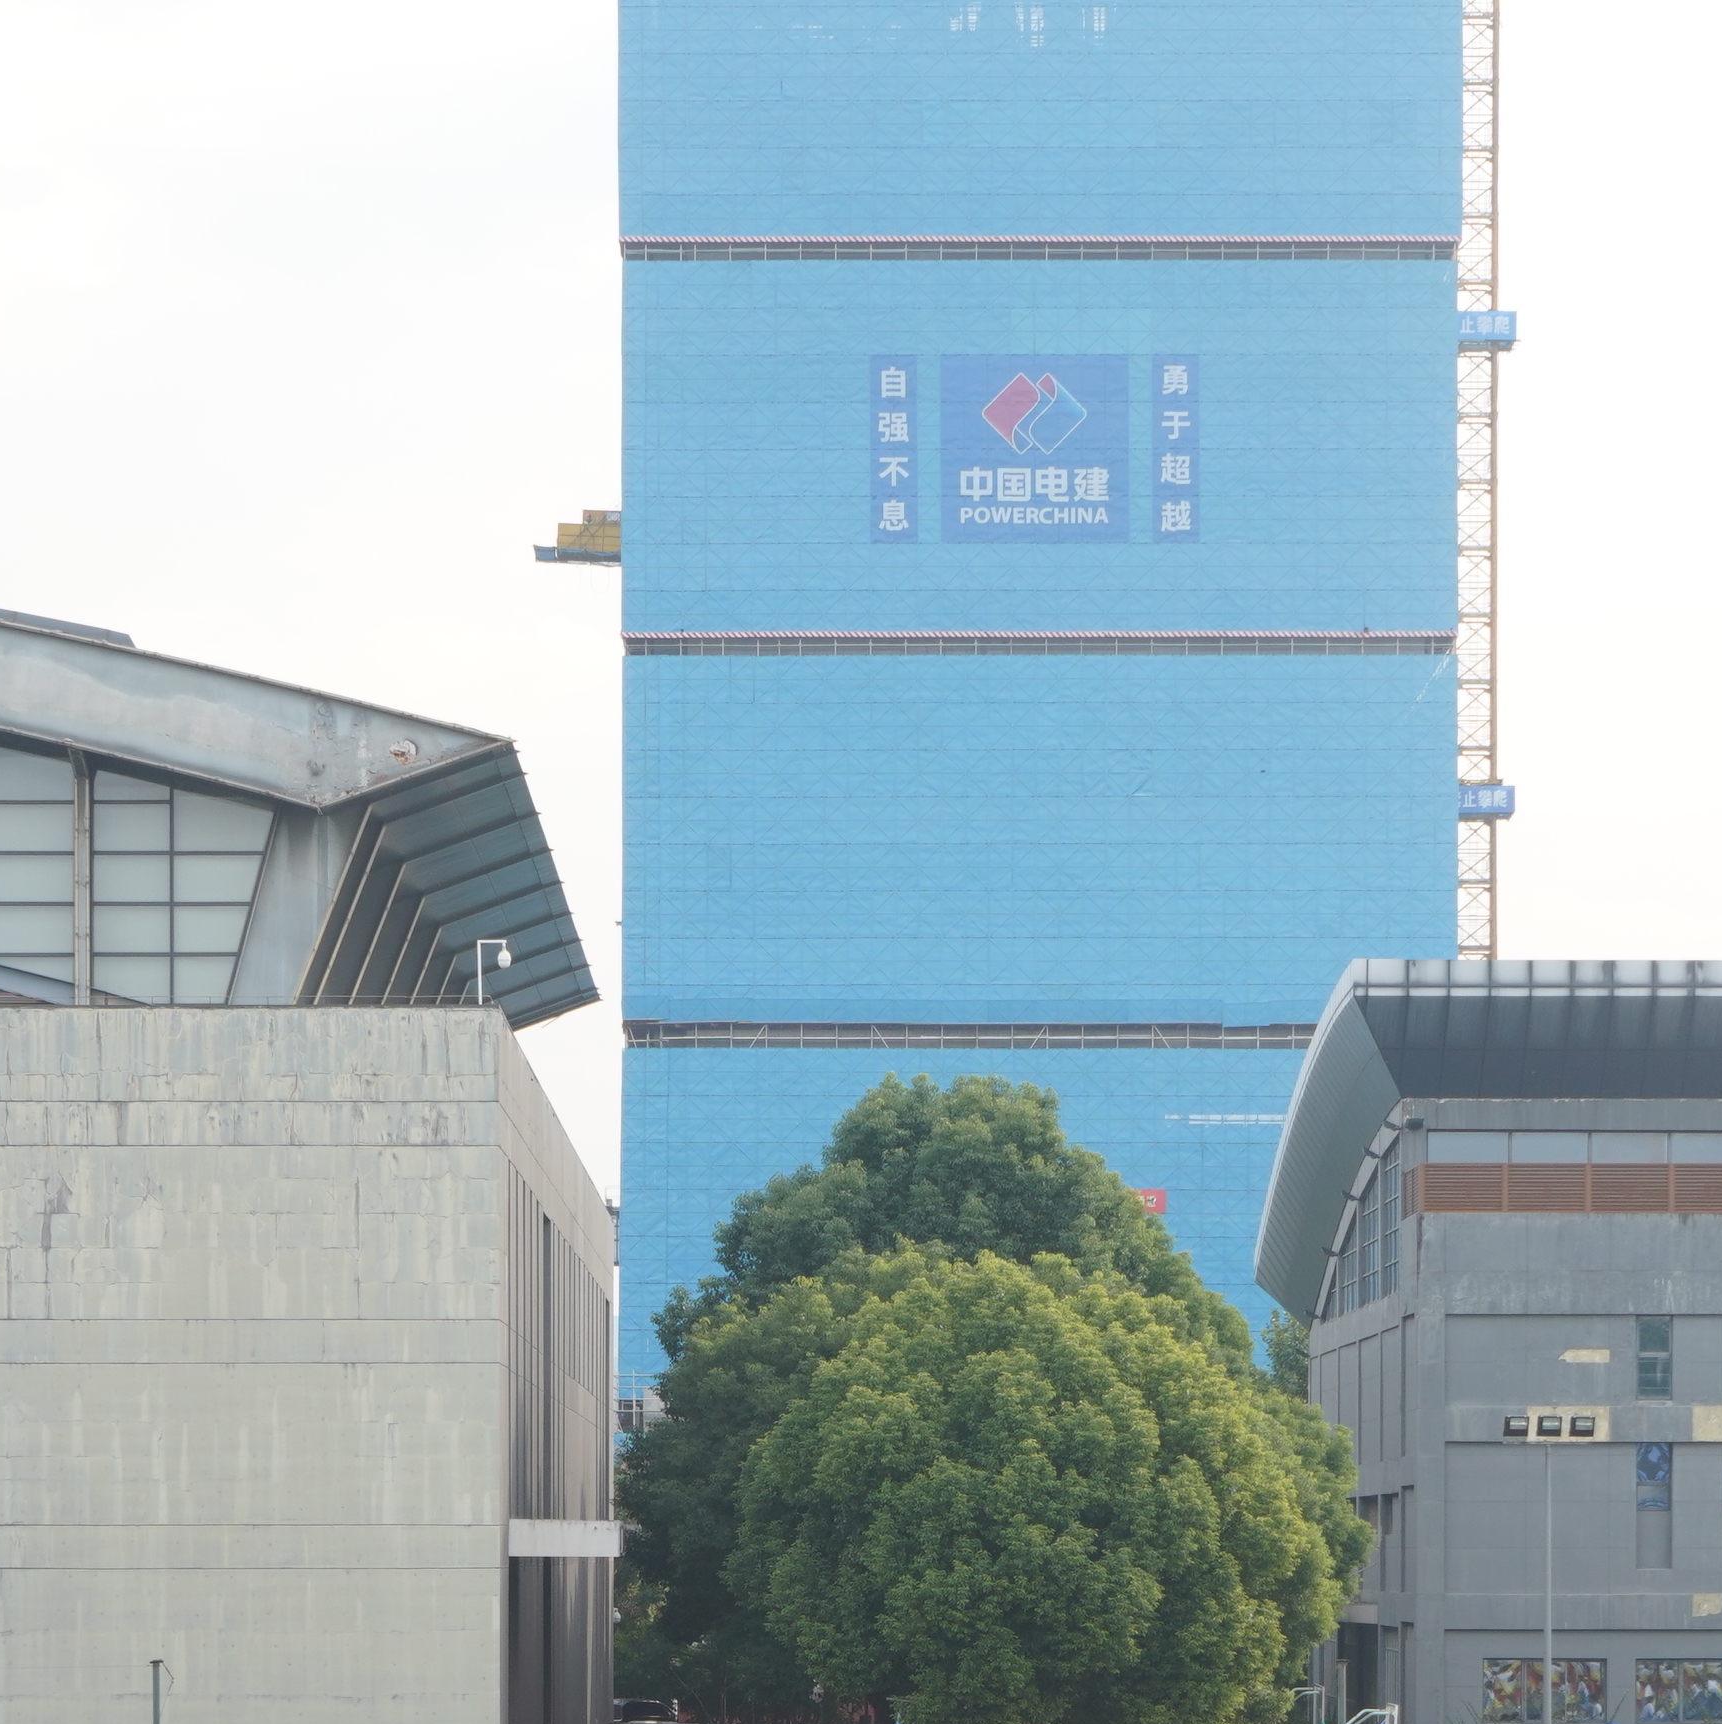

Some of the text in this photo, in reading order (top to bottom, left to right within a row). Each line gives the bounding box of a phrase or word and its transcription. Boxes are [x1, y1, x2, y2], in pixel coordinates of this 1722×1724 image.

[878, 365, 910, 535] 自强不息
[959, 466, 1110, 503] 中国电建
[1161, 363, 1193, 535] 勇于超越
[959, 507, 1110, 526] POWERCHINA
